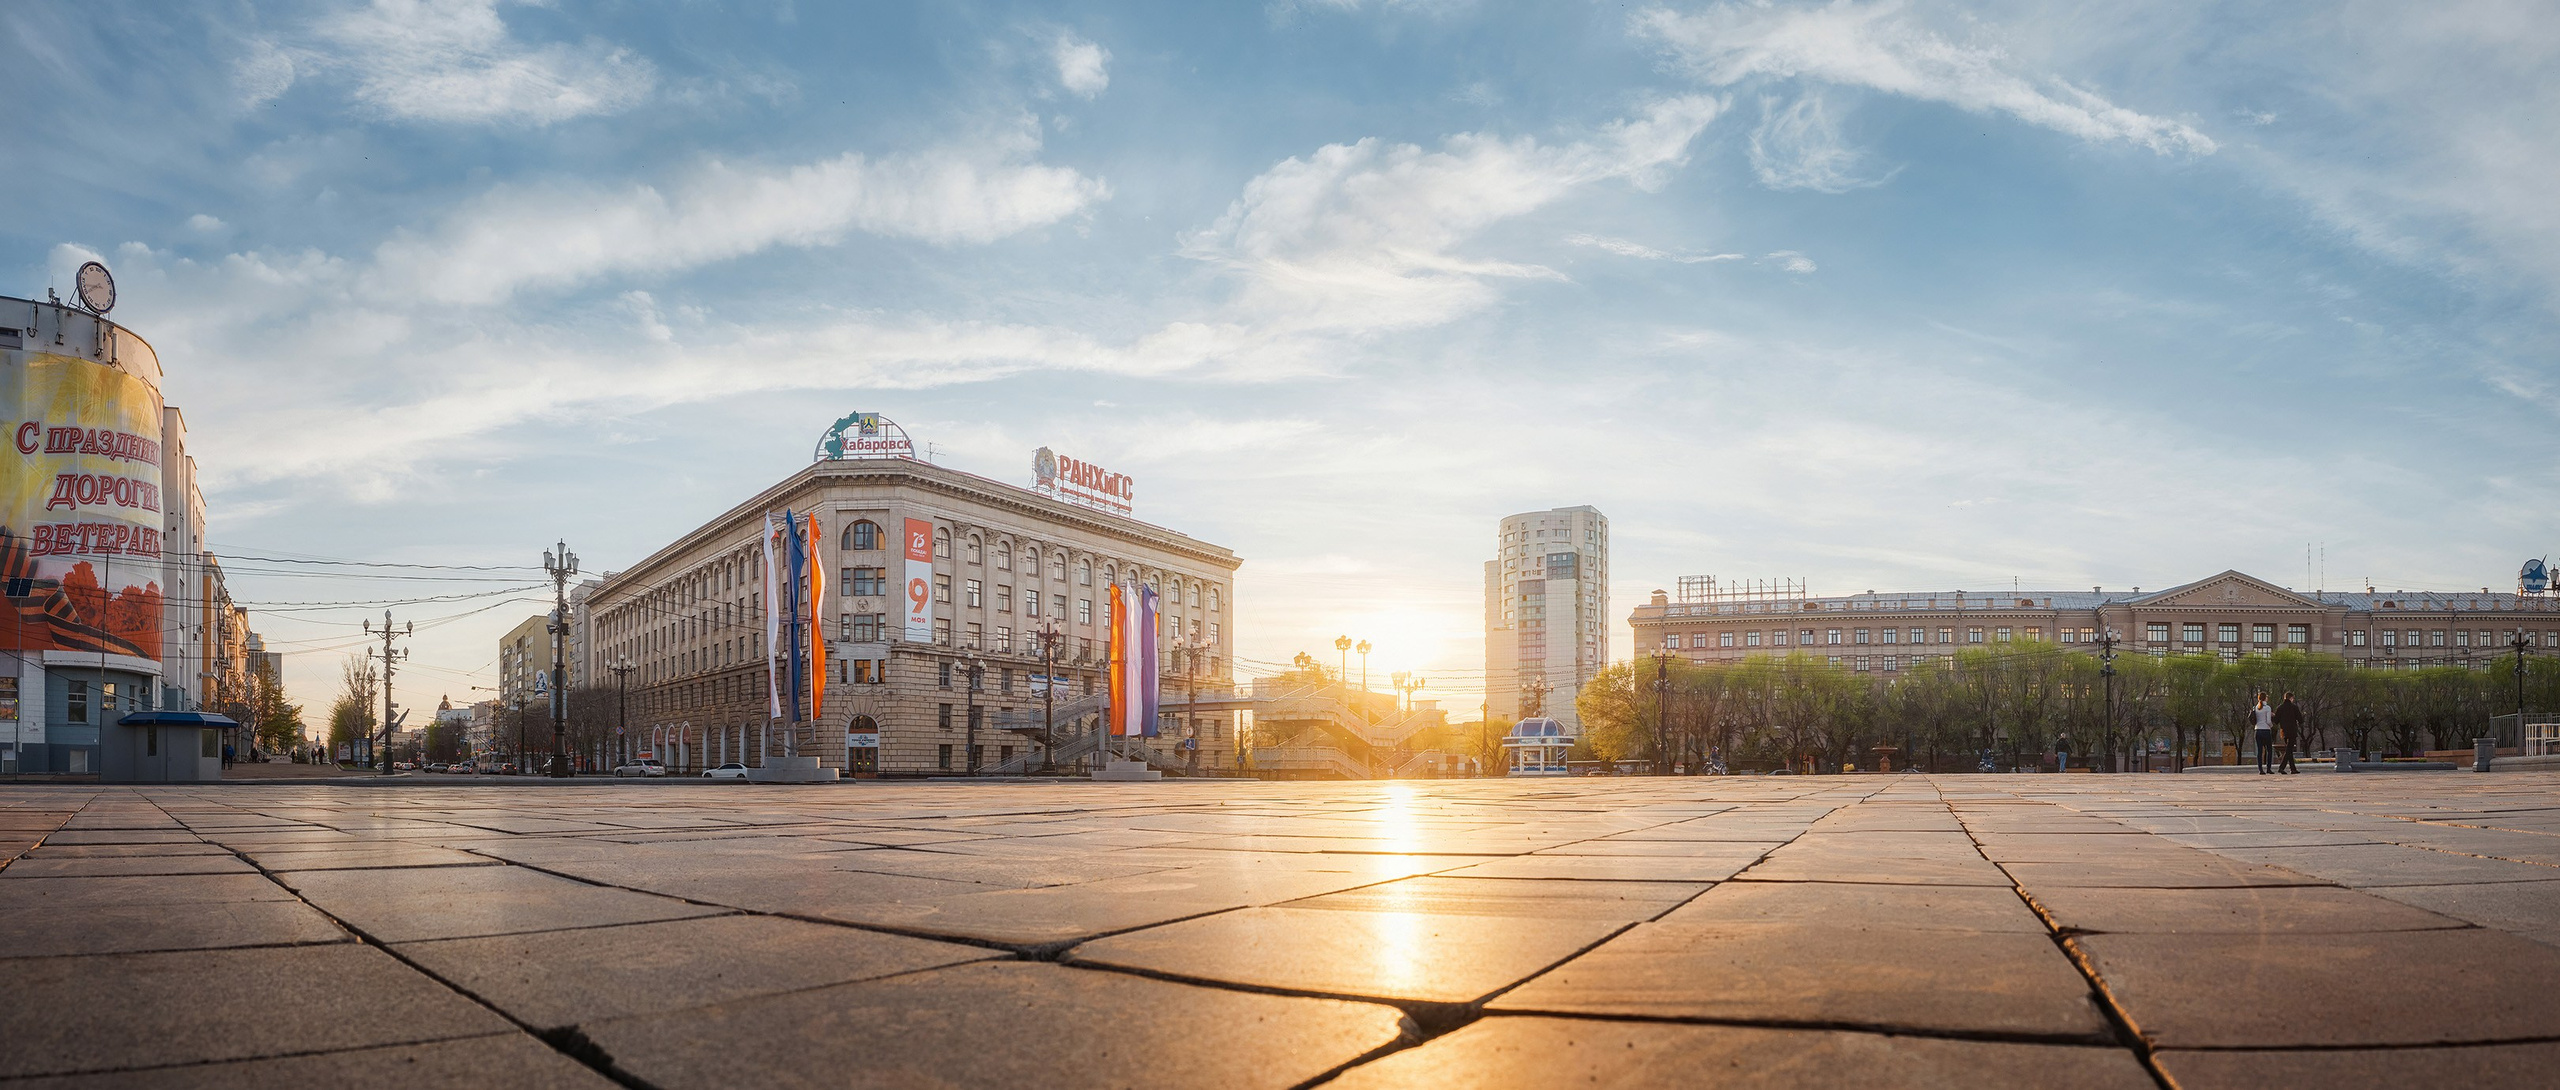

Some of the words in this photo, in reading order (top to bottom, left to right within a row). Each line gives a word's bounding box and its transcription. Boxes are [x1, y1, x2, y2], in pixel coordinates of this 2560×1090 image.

[16, 421, 40, 455] С
[840, 437, 912, 453] Хабаровск
[46, 473, 160, 514] ДОРОГИЕ
[1060, 455, 1133, 501] РАНХиГС
[908, 577, 929, 614] 9
